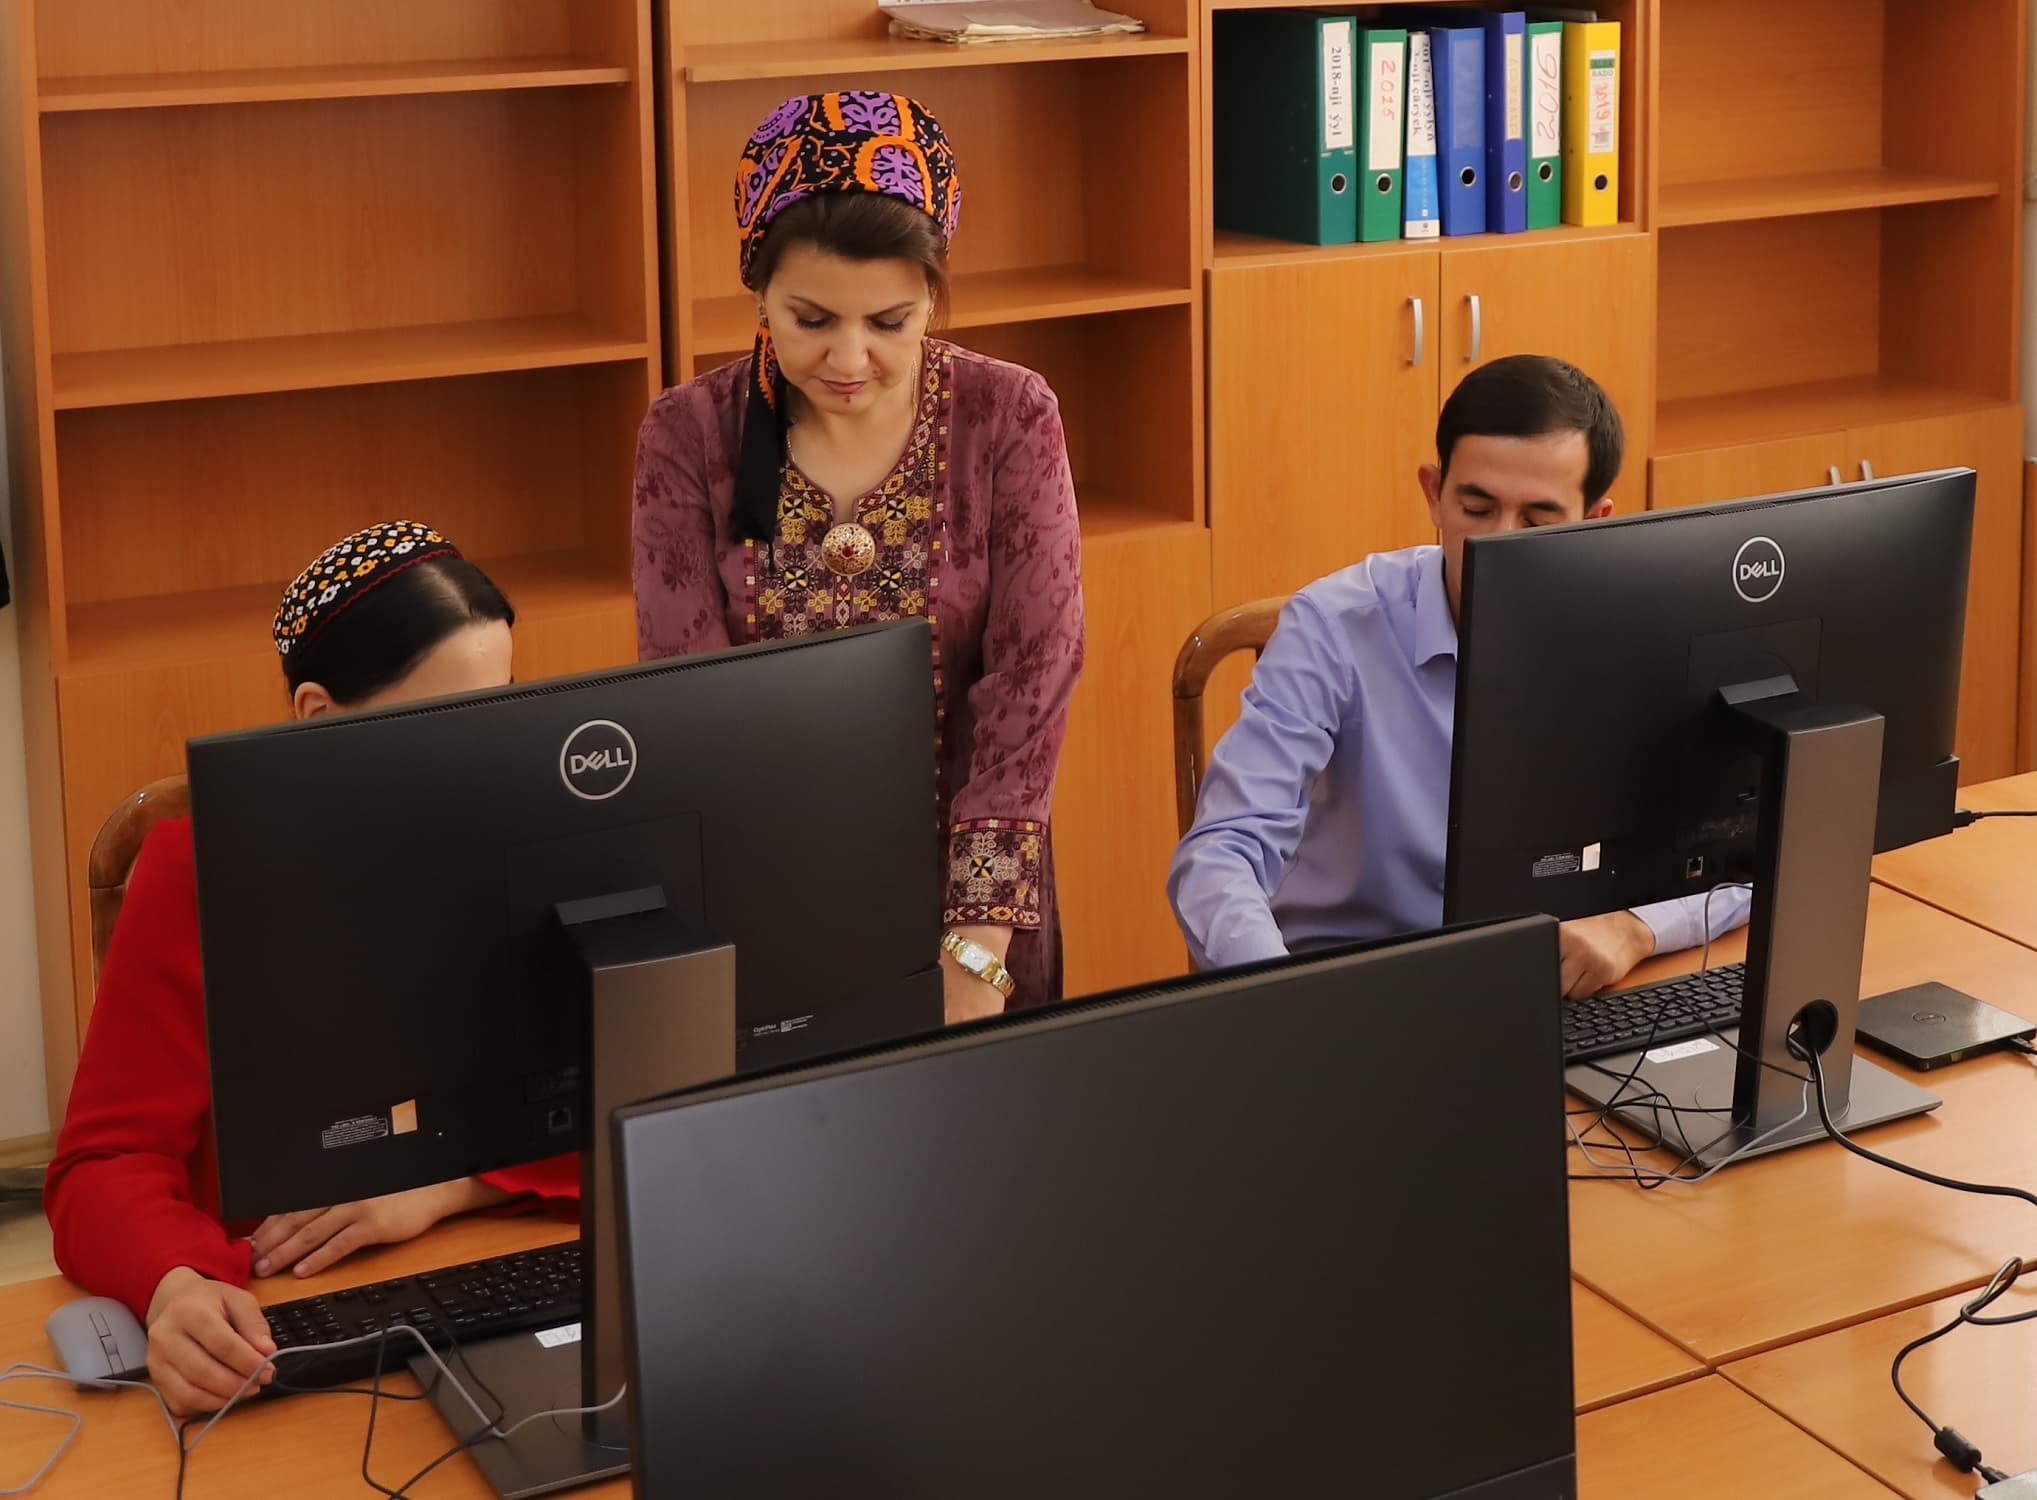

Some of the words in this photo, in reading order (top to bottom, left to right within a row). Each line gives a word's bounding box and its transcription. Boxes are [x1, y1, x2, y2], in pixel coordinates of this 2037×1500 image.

[1329, 47, 1342, 105] 2018-nji
[1380, 60, 1395, 121] 2015
[1537, 46, 1558, 141] 2016
[1740, 560, 1779, 580] DELL
[571, 747, 629, 774] DELL
